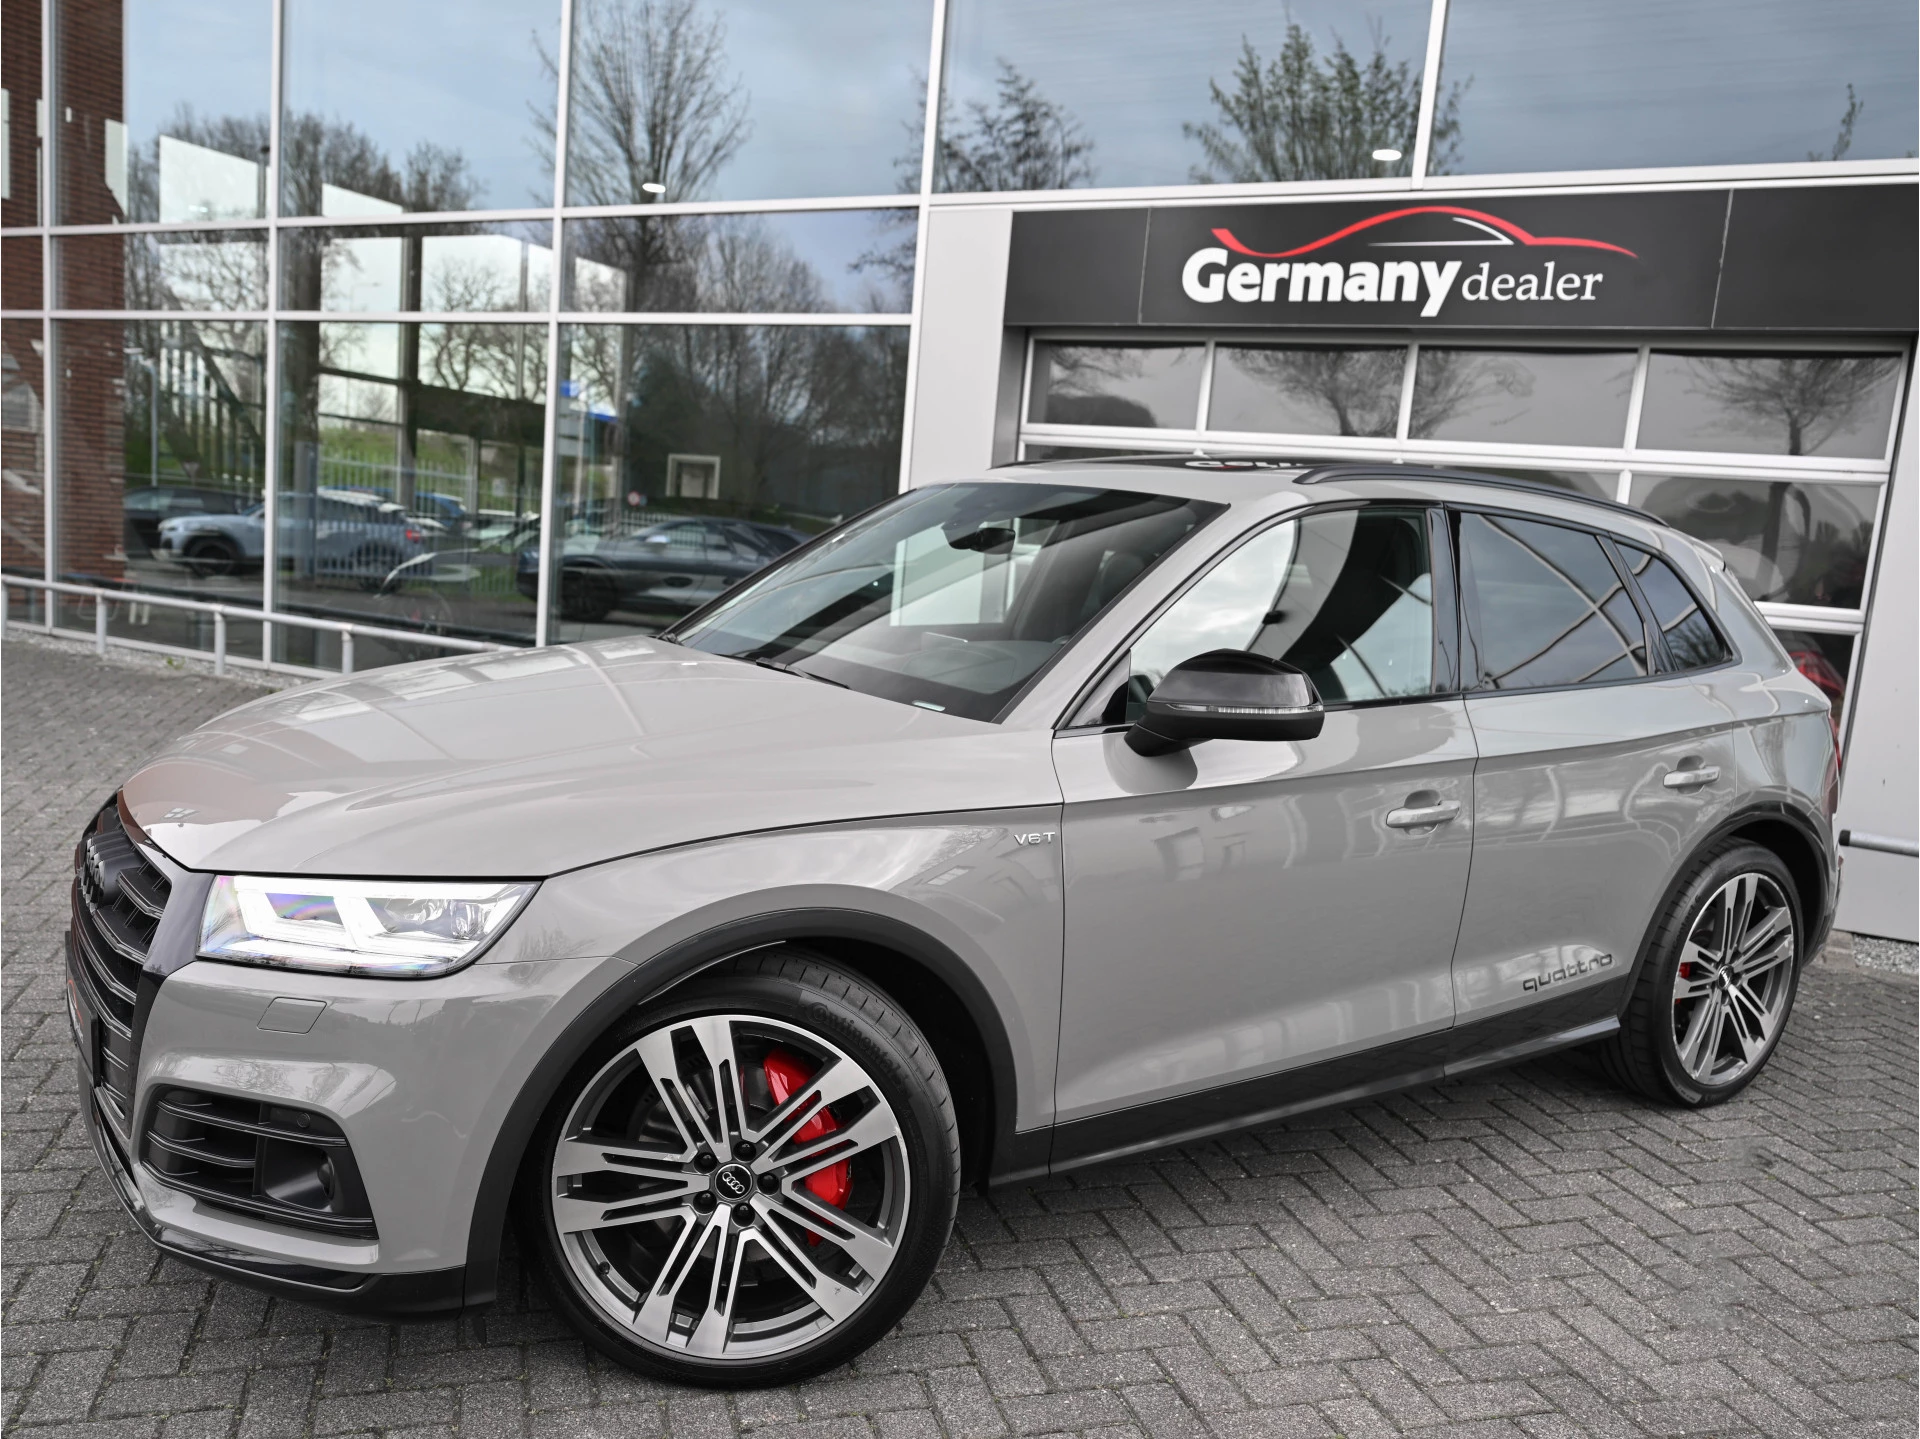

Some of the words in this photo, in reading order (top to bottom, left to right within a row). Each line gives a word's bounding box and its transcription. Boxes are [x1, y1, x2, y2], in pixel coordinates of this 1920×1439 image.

[1182, 247, 1462, 317] Germany
[1461, 261, 1604, 301] dealer
[1522, 953, 1613, 992] quattro
[804, 1001, 901, 1075] Continental
